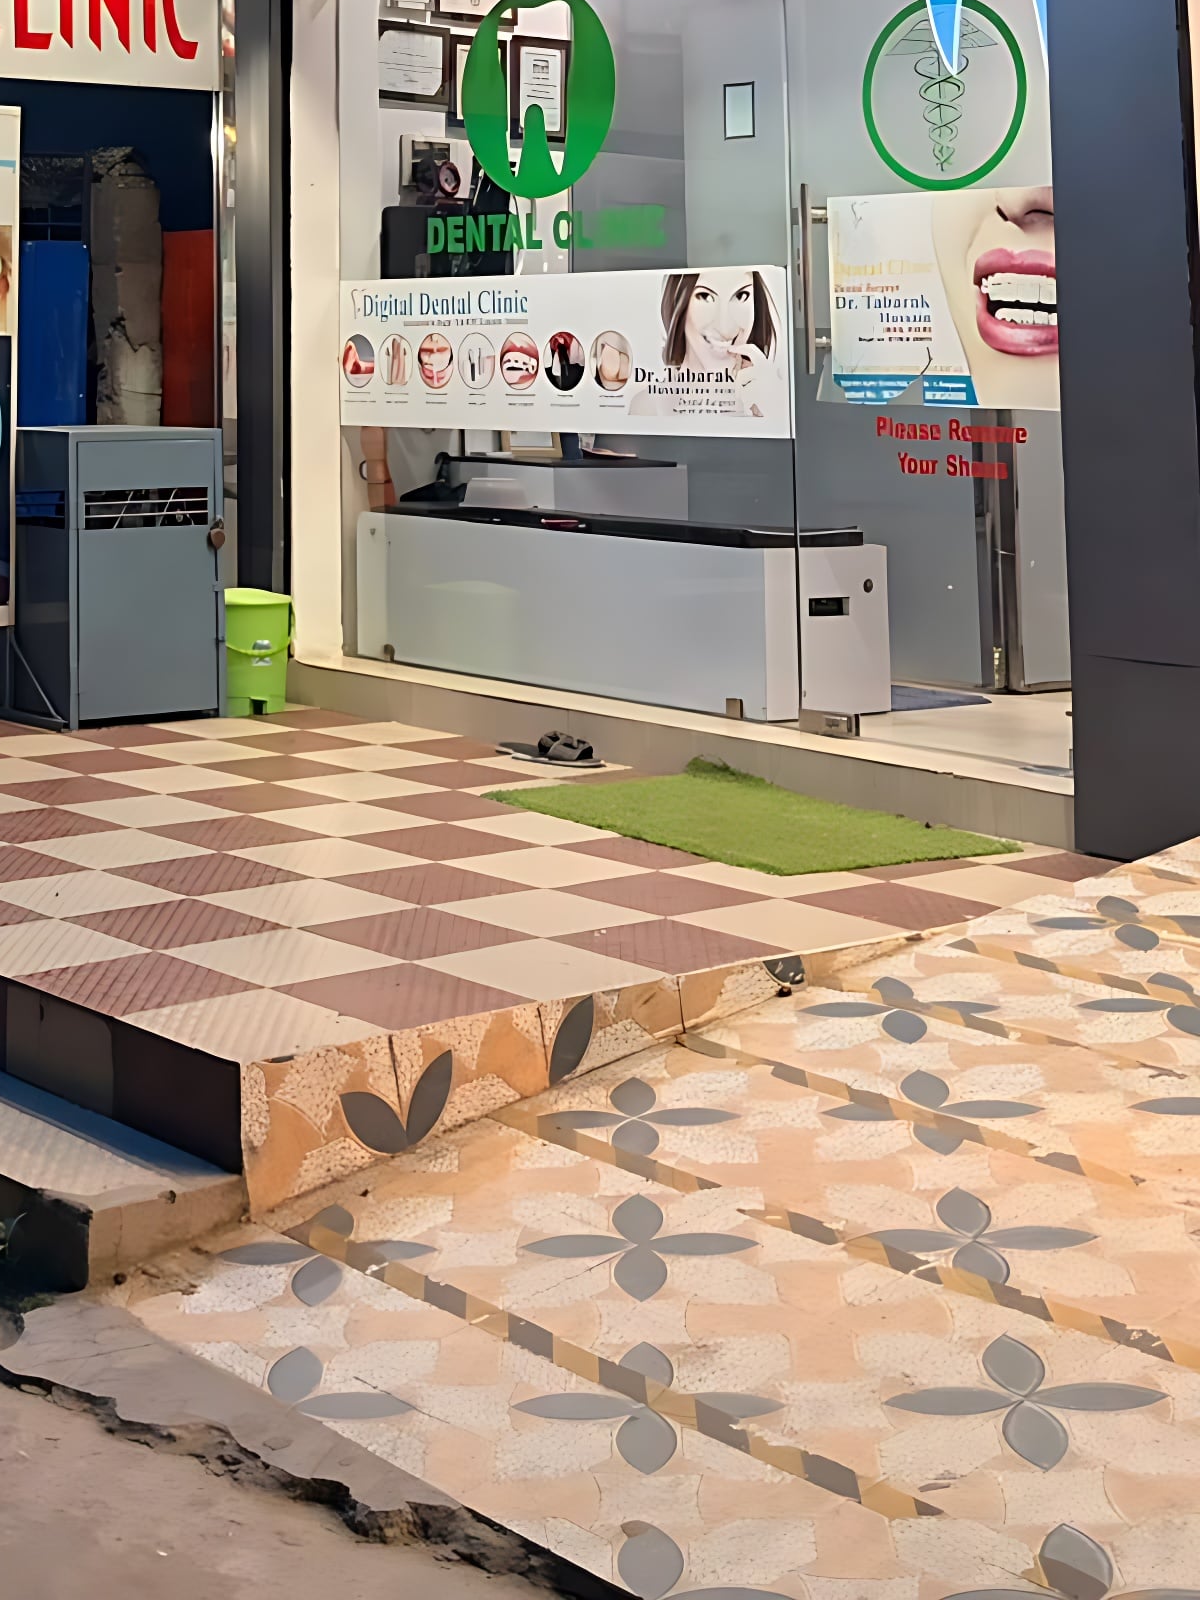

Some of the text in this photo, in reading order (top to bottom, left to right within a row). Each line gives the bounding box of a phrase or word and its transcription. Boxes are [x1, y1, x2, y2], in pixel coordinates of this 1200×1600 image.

[427, 210, 543, 254] DENTAL
[363, 289, 529, 323] Digital Dental Clinic
[876, 416, 1028, 444] Please Ree
[897, 451, 939, 475] Your
